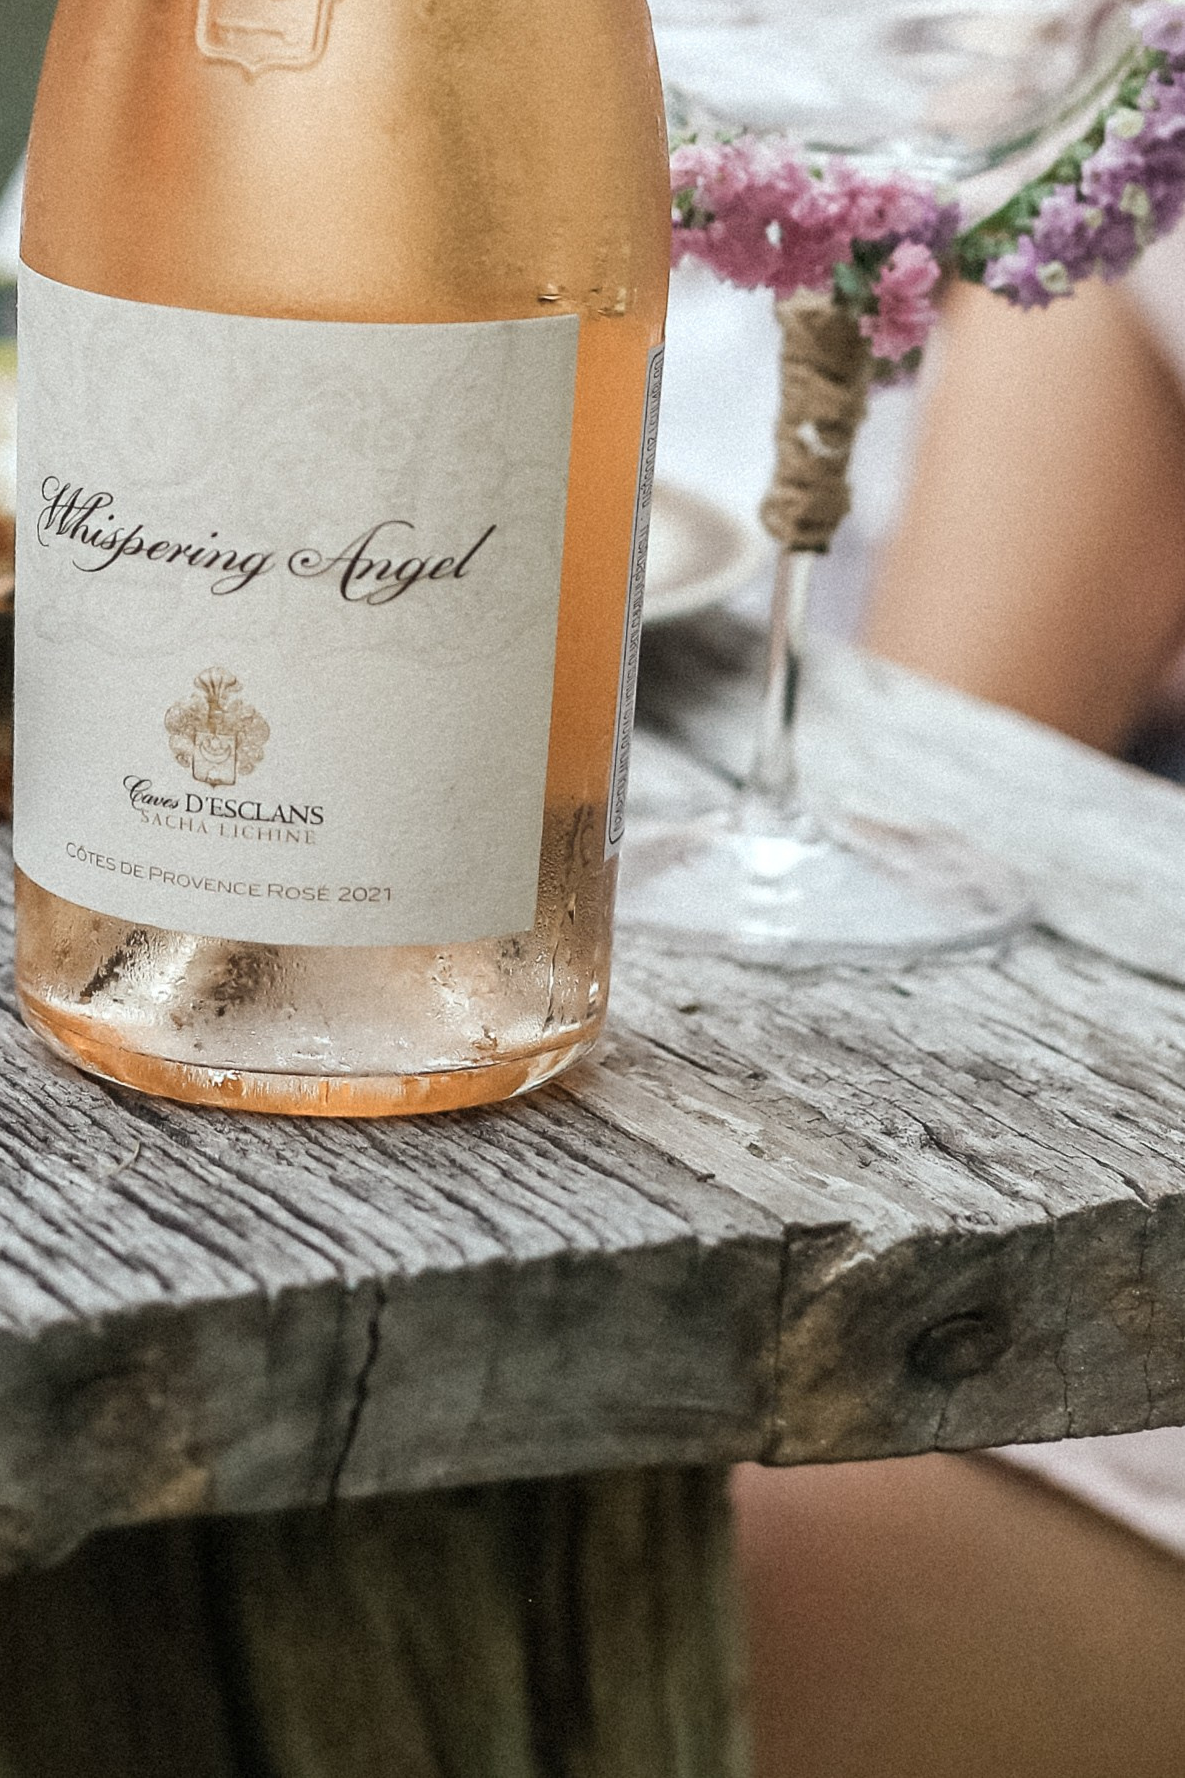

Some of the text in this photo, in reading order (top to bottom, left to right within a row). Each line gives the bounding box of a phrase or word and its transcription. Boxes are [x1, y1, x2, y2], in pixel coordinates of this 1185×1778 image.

[37, 476, 497, 605] Whispering Angel
[123, 775, 324, 825] Caves D'ESCLANS
[140, 809, 316, 845] SACHA LICHINE
[66, 842, 392, 902] CÔTES DE PROVENCE ROSÉ 2021
